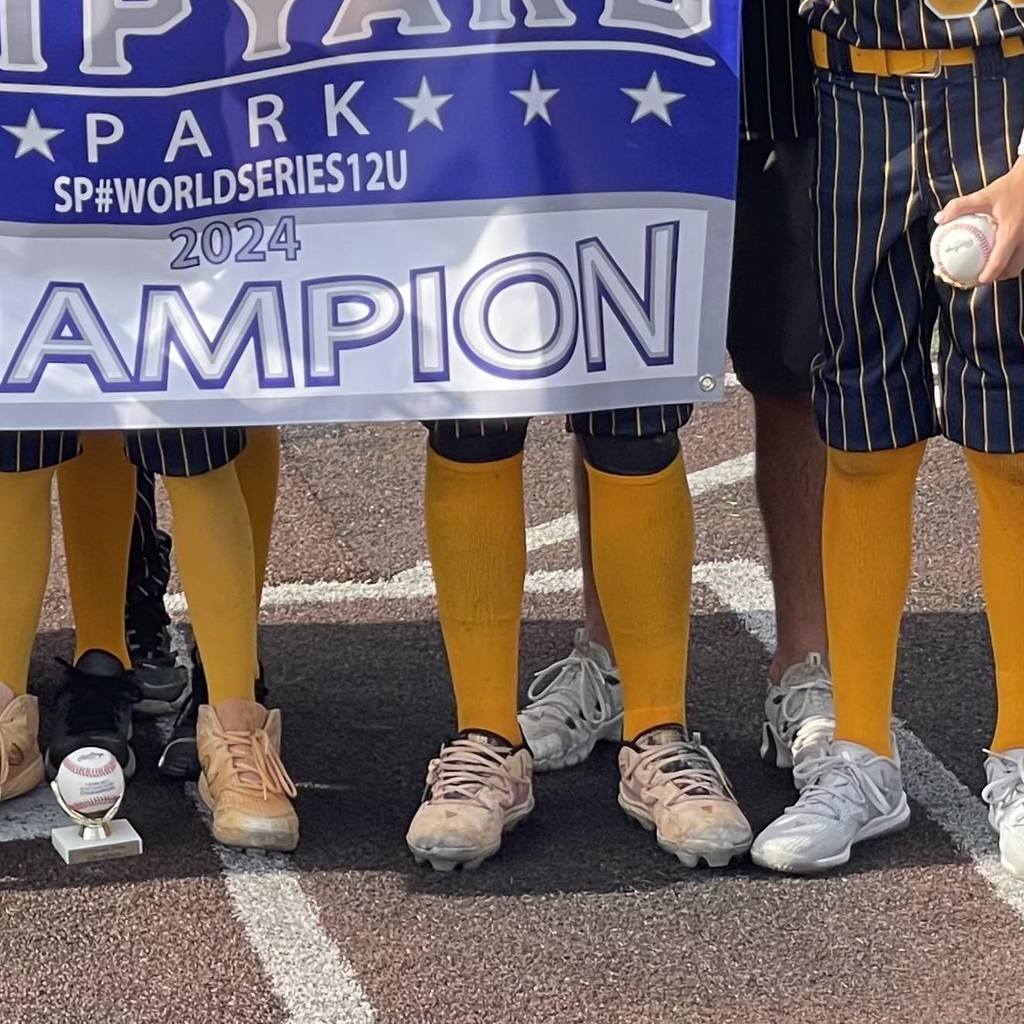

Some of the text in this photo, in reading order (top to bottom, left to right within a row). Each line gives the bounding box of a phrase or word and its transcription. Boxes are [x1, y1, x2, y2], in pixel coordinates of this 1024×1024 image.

[85, 80, 371, 164] PARK
[53, 149, 408, 214] SP#WORLDSERIES12U
[169, 215, 301, 270] 2024
